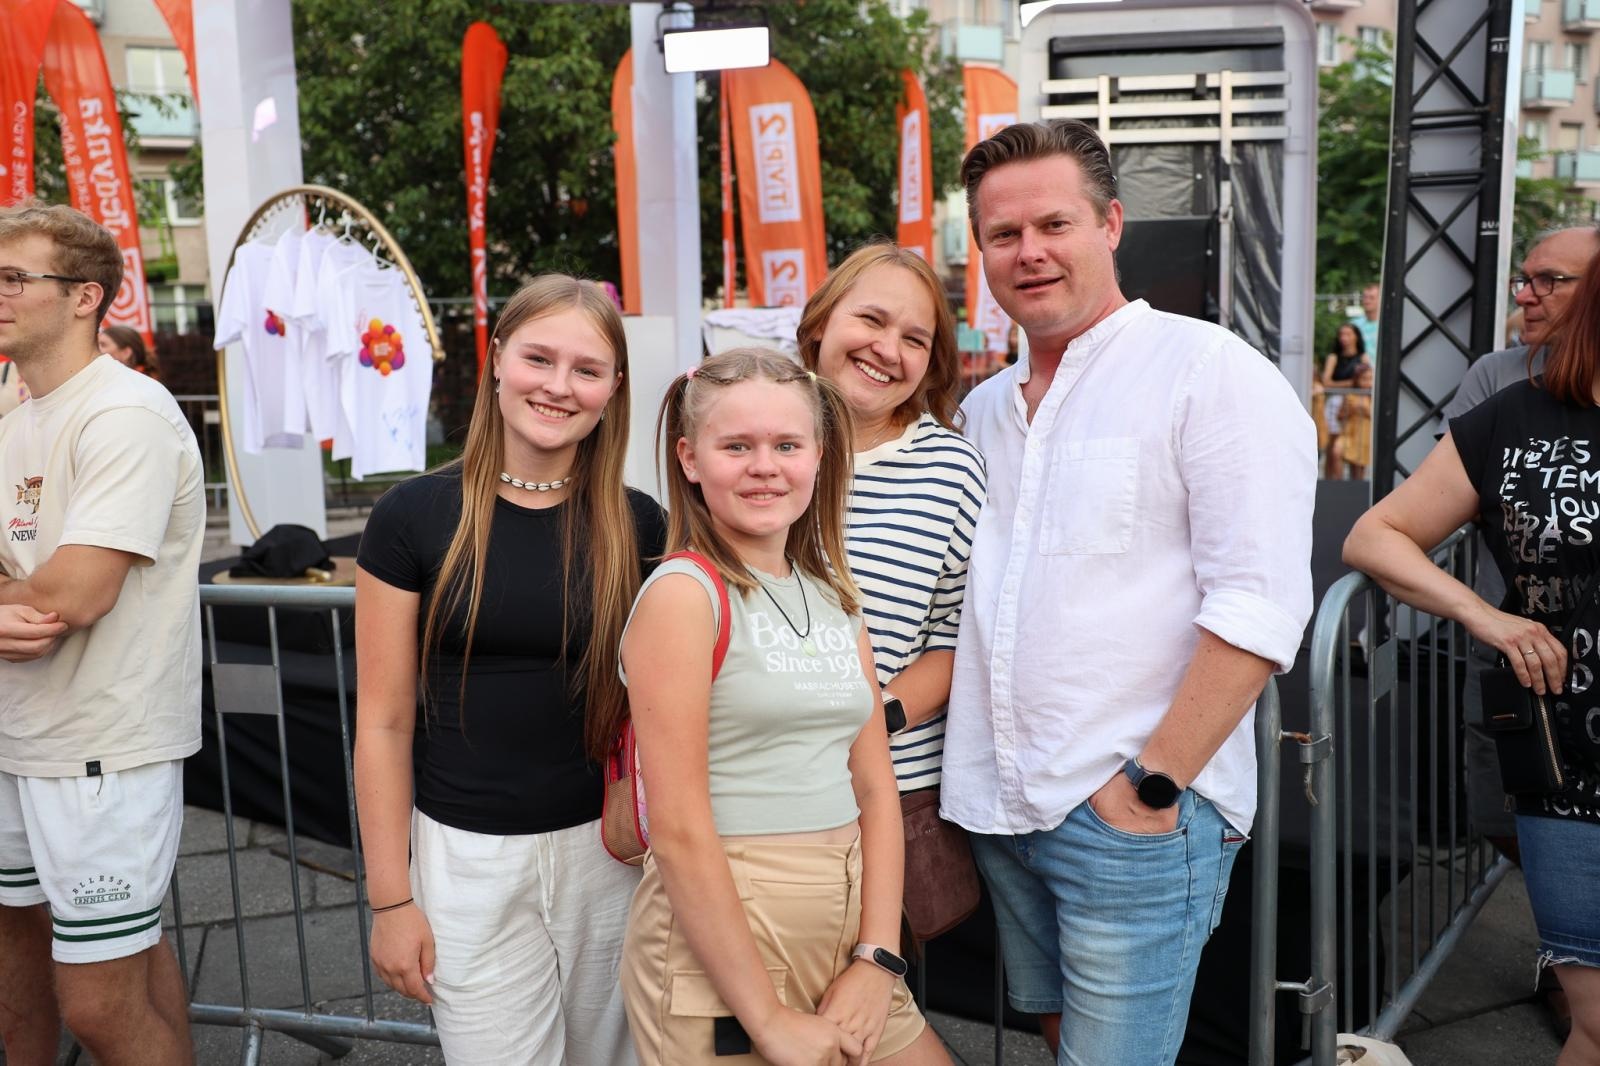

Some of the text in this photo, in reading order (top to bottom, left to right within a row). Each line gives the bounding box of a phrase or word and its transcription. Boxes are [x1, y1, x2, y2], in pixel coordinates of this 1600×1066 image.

[11, 100, 28, 158] RADIO
[11, 530, 37, 542] NEW
[750, 611, 858, 653] Boto
[766, 650, 862, 679] Since 199
